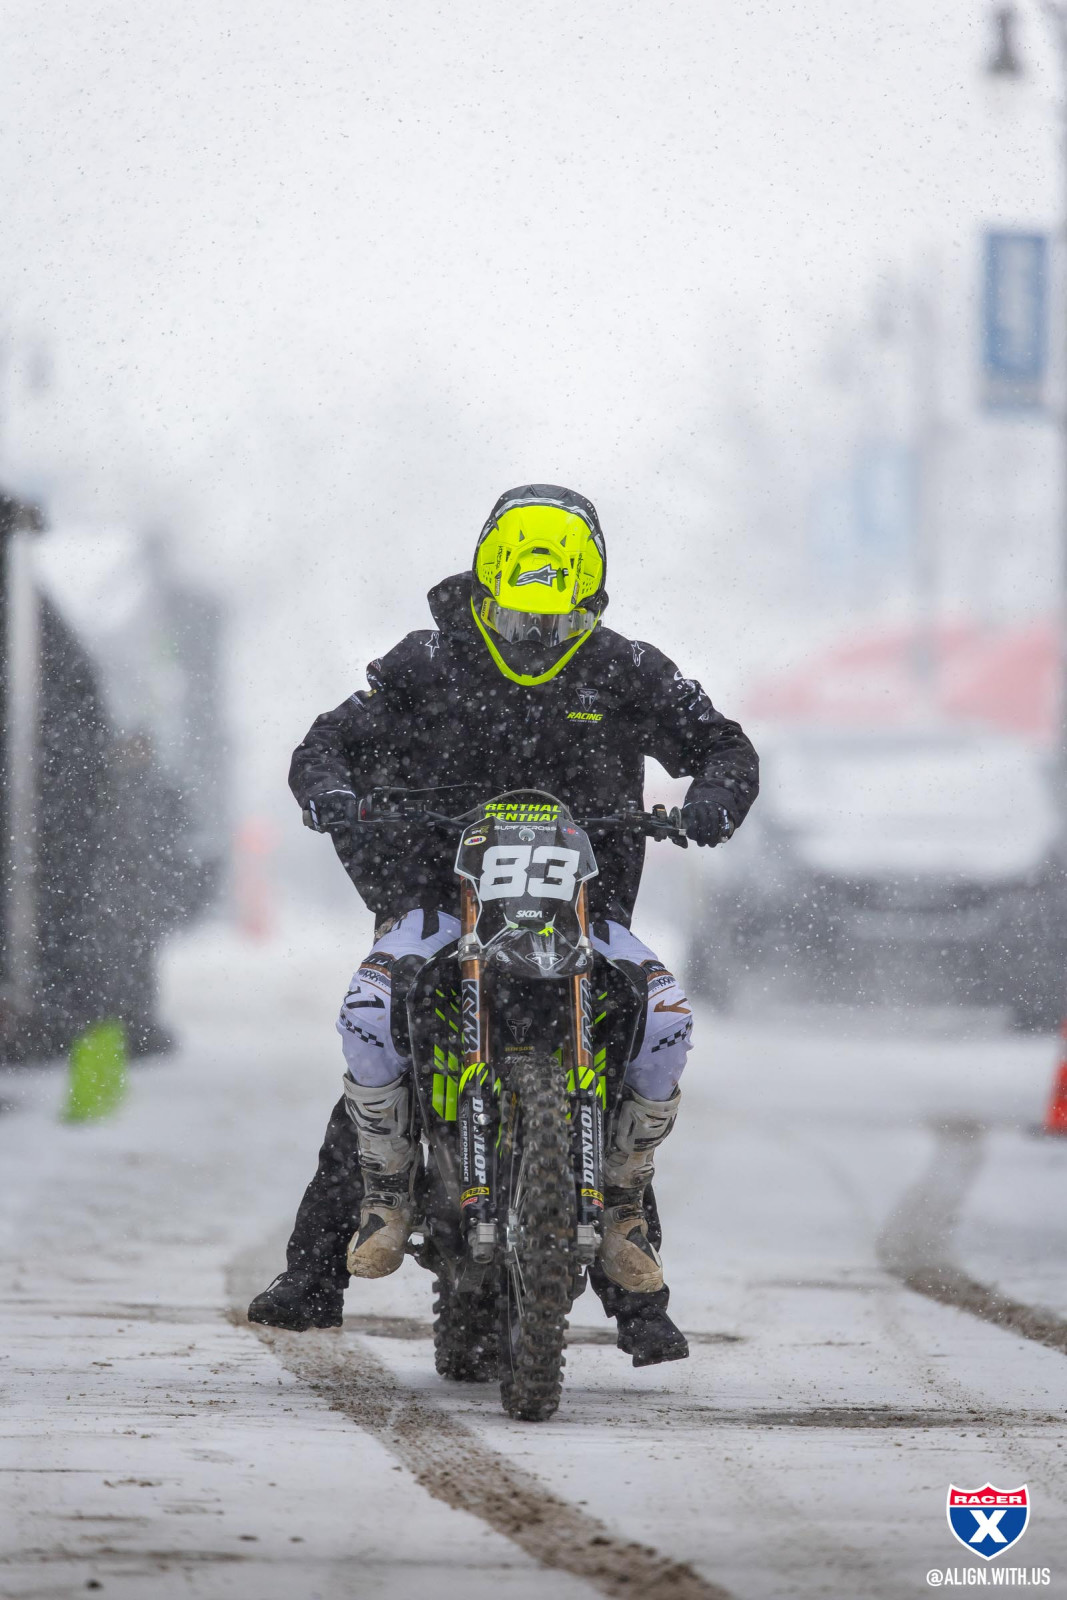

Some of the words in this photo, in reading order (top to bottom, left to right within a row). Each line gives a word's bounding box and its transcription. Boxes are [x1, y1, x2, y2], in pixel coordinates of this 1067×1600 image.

[567, 711, 603, 720] RACING
[485, 803, 562, 812] RENTHAL
[480, 845, 581, 902] 83
[462, 1120, 470, 1182] PERFORMANCE
